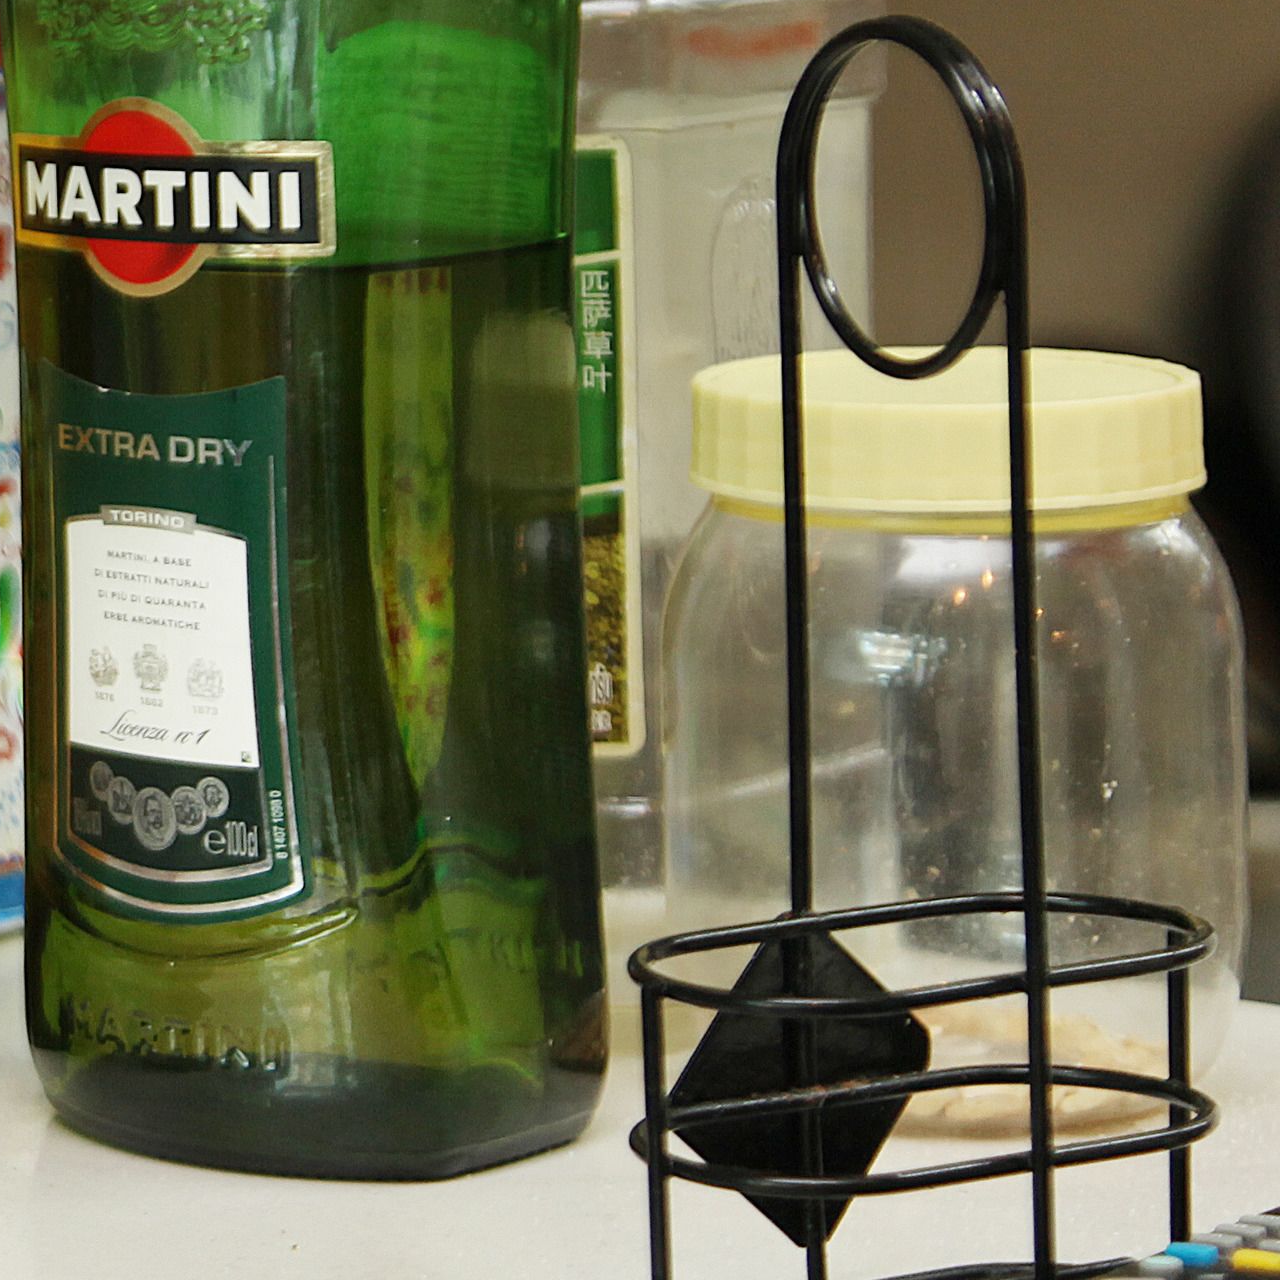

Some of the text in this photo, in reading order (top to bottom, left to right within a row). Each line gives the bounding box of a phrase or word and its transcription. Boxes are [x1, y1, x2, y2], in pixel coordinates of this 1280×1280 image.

[24, 160, 303, 231] MARTINI
[57, 422, 254, 467] EXTRA DRY
[108, 509, 186, 529] TORINO
[163, 556, 192, 567] BASE
[106, 569, 152, 584] ESTRATTI
[154, 577, 210, 590] NATURALI
[144, 596, 207, 610] QUARANTA
[103, 610, 201, 631] ERBE AROMATICHE
[100, 708, 169, 742] Licenza
